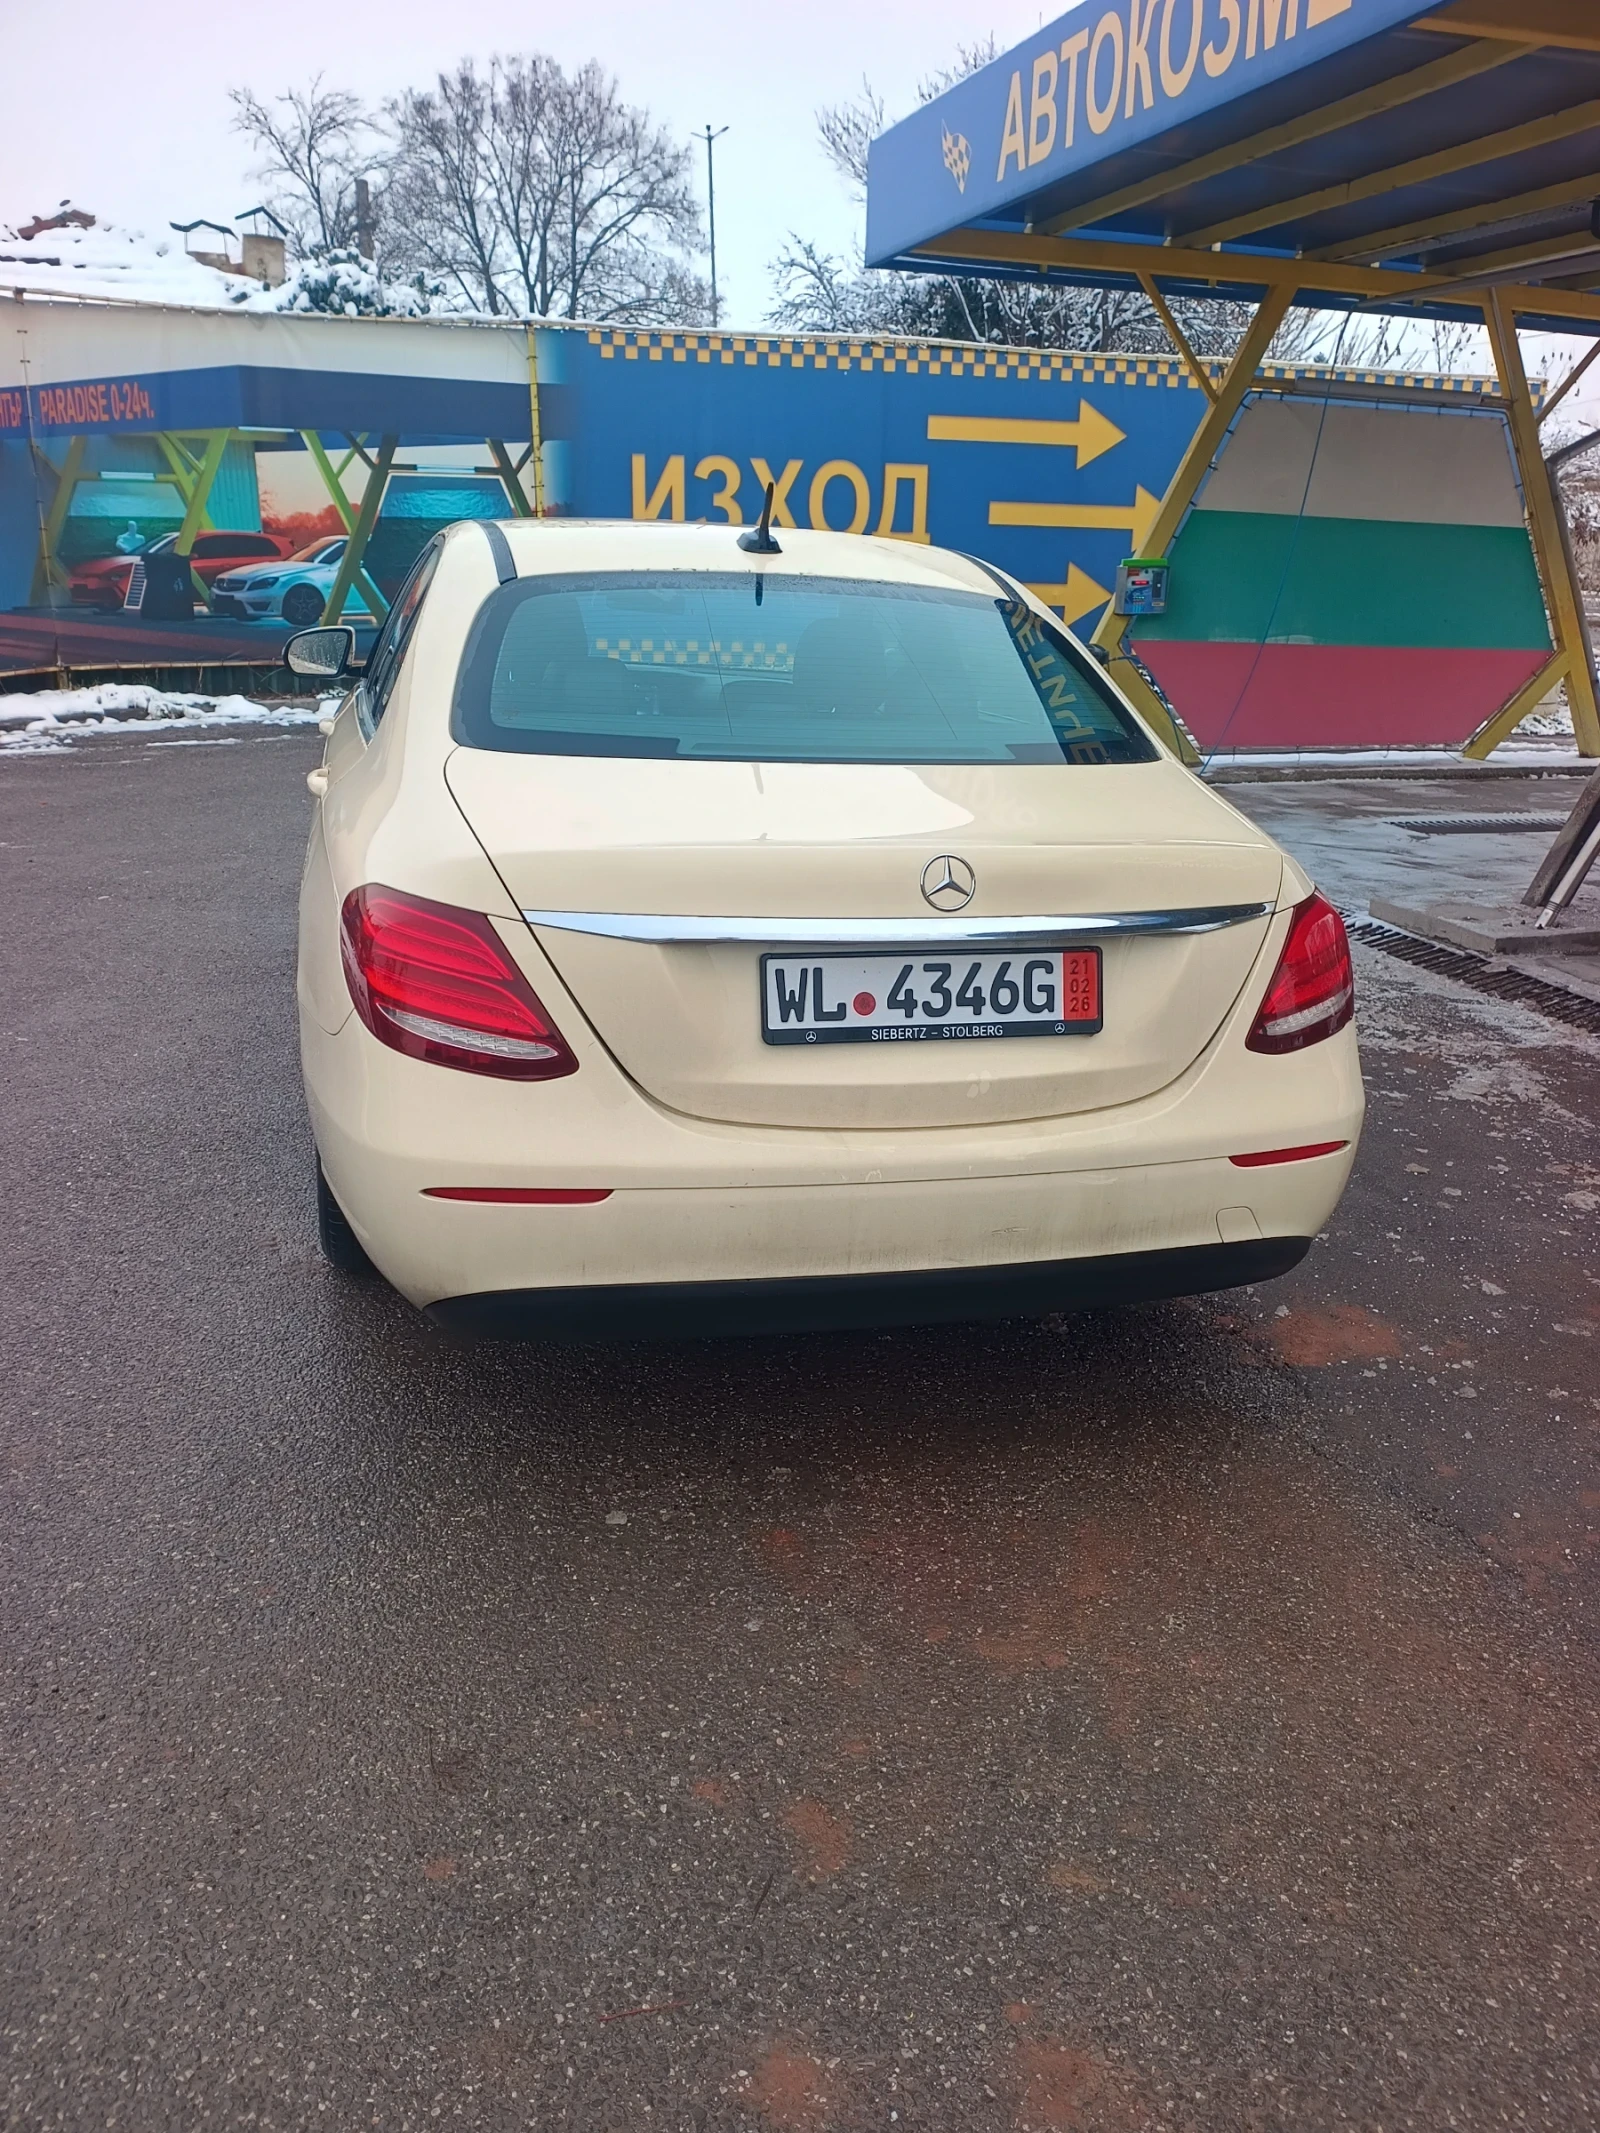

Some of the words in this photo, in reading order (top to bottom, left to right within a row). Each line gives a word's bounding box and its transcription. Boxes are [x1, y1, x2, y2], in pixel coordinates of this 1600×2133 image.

[997, 0, 1352, 182] АВТОКОЗ
[39, 384, 109, 425] PARADISE
[631, 453, 930, 545] ИЗХОД
[1070, 959, 1088, 975] 21
[774, 966, 847, 1023] WL
[886, 959, 1055, 1019] 4346G
[1070, 978, 1090, 994] 02
[1070, 996, 1090, 1013] 26
[871, 1027, 927, 1040] SIEBERTZ
[942, 1025, 1003, 1038] STOLBERG
